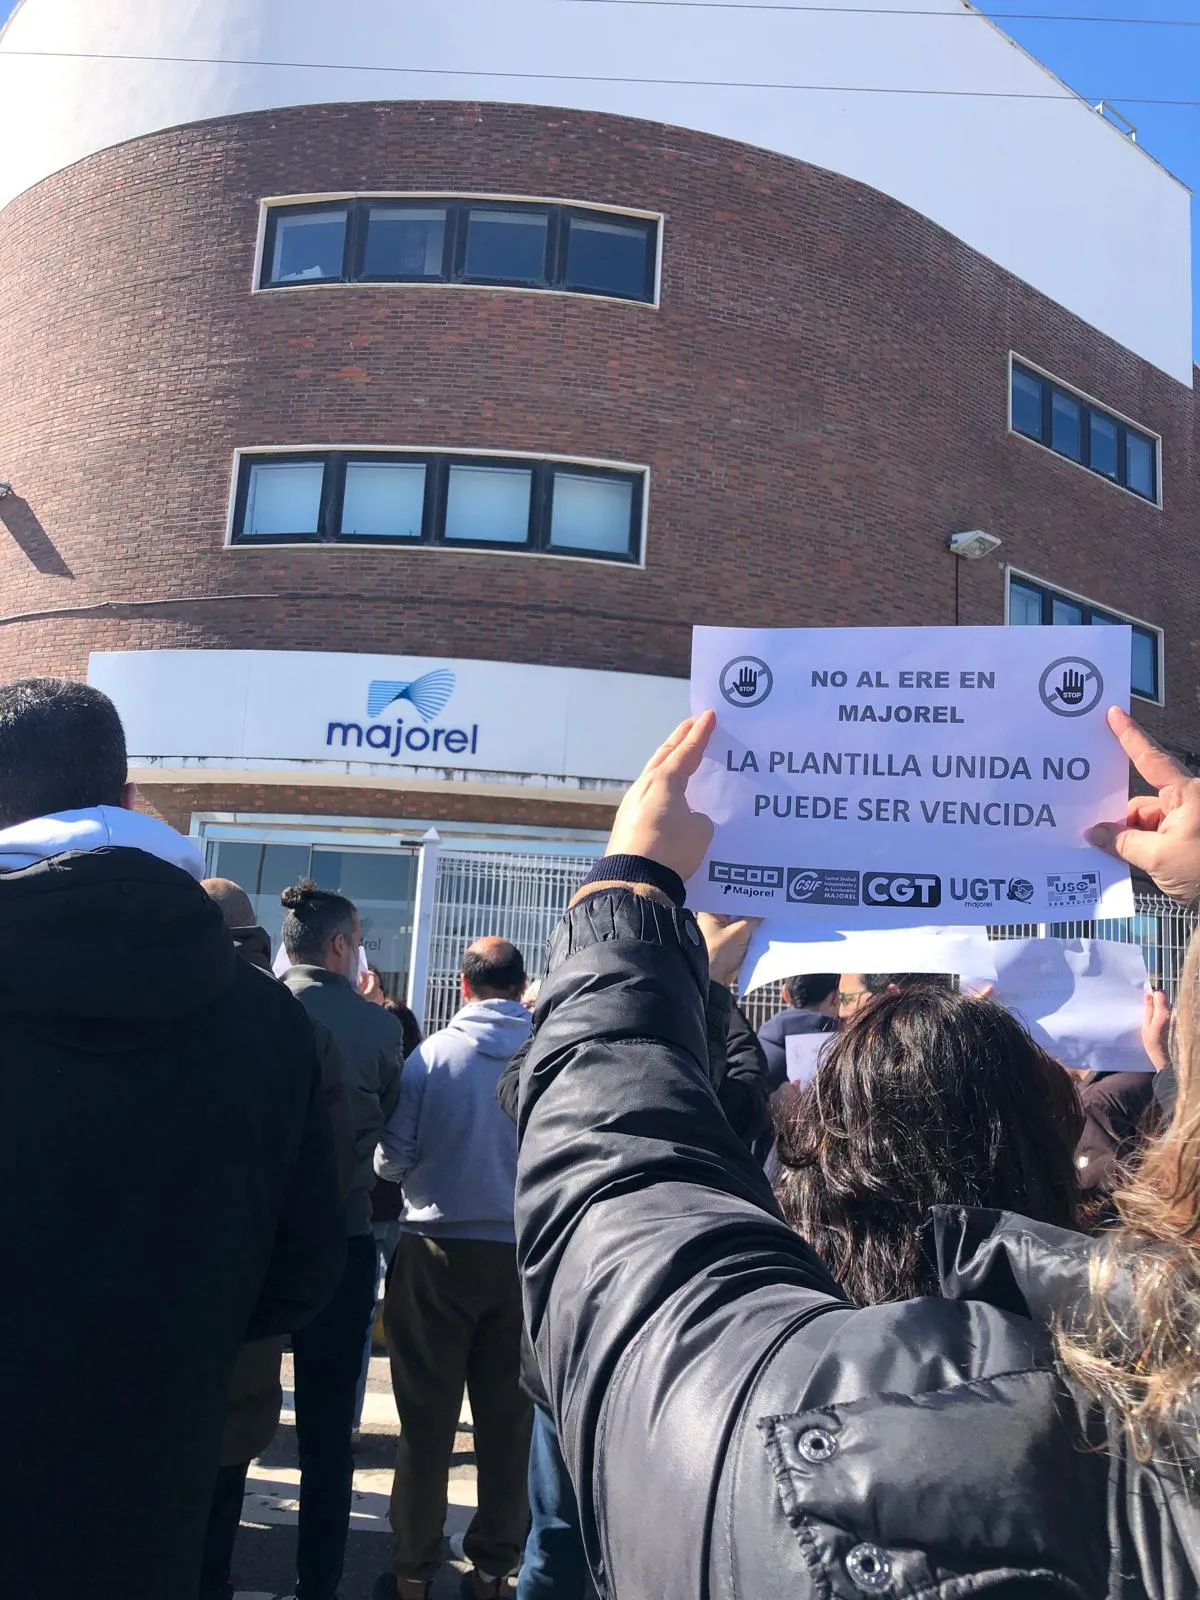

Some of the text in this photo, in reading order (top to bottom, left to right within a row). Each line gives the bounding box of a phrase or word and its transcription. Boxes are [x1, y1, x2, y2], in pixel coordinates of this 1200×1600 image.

[811, 671, 995, 688] NO AL ERE EN
[838, 705, 964, 723] MAJOREL
[326, 718, 478, 757] majorel
[727, 750, 1090, 780] LA PLANTILLA UNIDA NO
[754, 795, 1056, 827] PUEDE SER VENCIDA
[714, 866, 779, 883] CCOO
[733, 887, 774, 897] Majorel
[795, 880, 822, 890] CSIF
[868, 877, 936, 902] CGT
[951, 878, 1006, 901] UGT
[1055, 882, 1089, 892] USO
